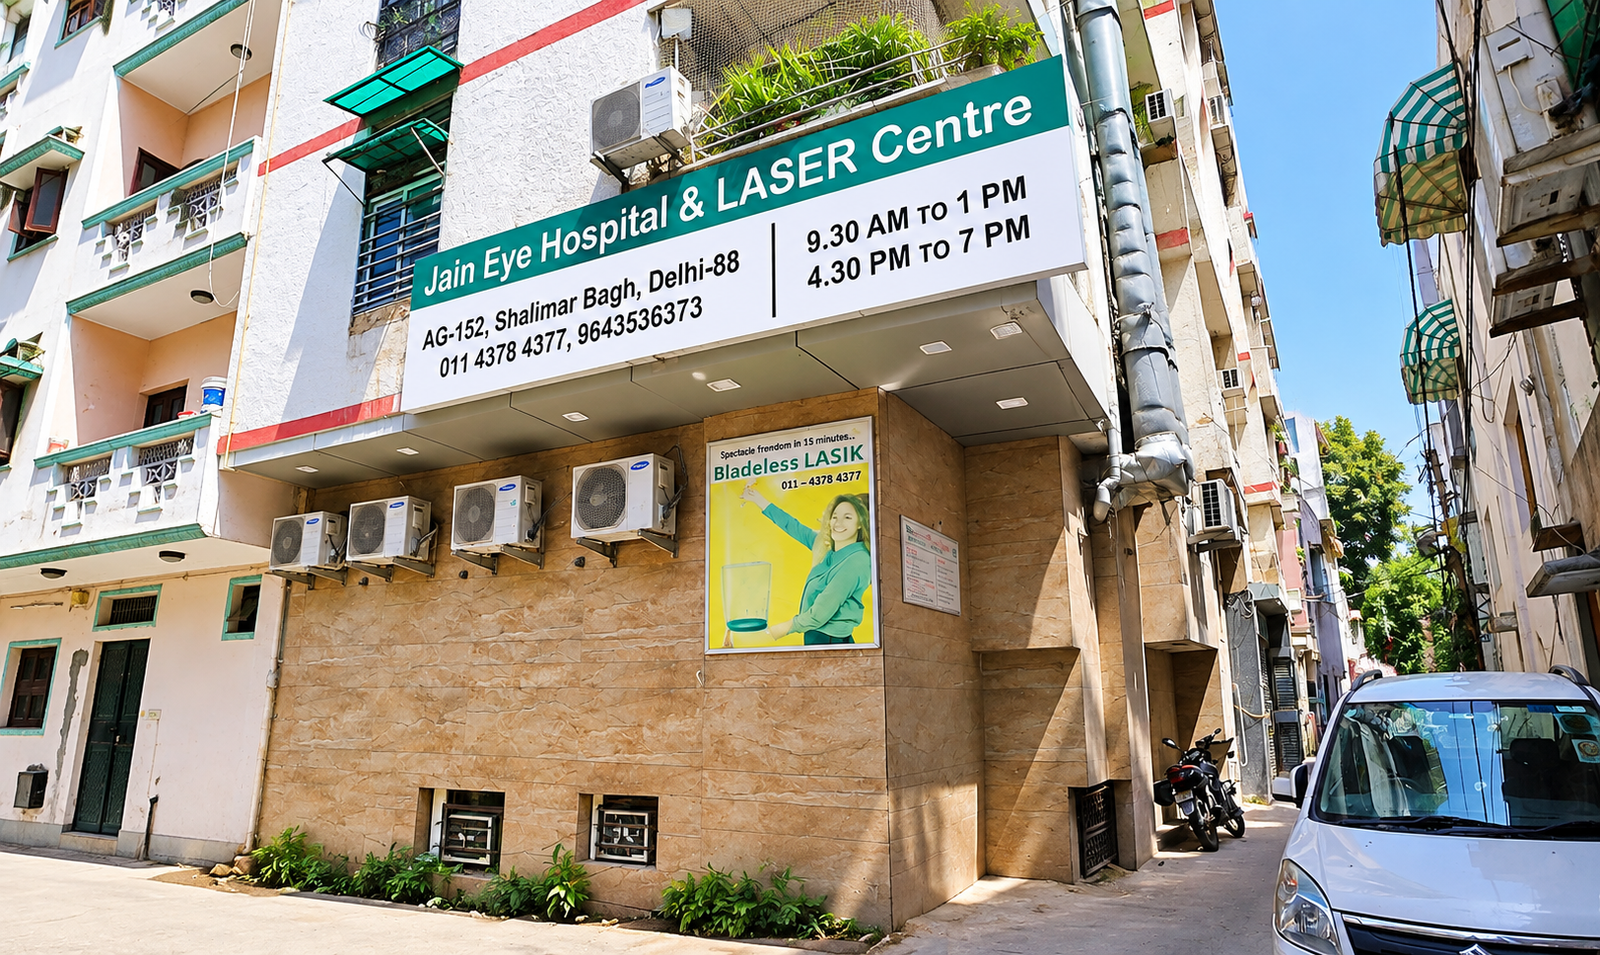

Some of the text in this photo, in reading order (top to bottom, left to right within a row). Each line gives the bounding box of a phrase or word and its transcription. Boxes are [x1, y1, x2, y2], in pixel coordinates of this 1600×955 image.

[424, 95, 1032, 296] Jain Eye Hospital & LASER Centre
[807, 175, 1026, 253] 9.30 AM TO 1 PM
[808, 214, 1030, 288] 4.30 PM TO 7 PM
[422, 250, 740, 350] AG-152, Shalimar Bagh, Delhi-88
[440, 296, 702, 378] 011 4378 4377, 9643536373
[714, 444, 864, 481] Bladeless LASIK
[721, 446, 755, 460] Spectacle
[794, 439, 801, 448] in
[804, 438, 814, 446] 15
[782, 480, 798, 490] 011
[808, 475, 833, 486] 4378
[835, 471, 862, 482] 4377
